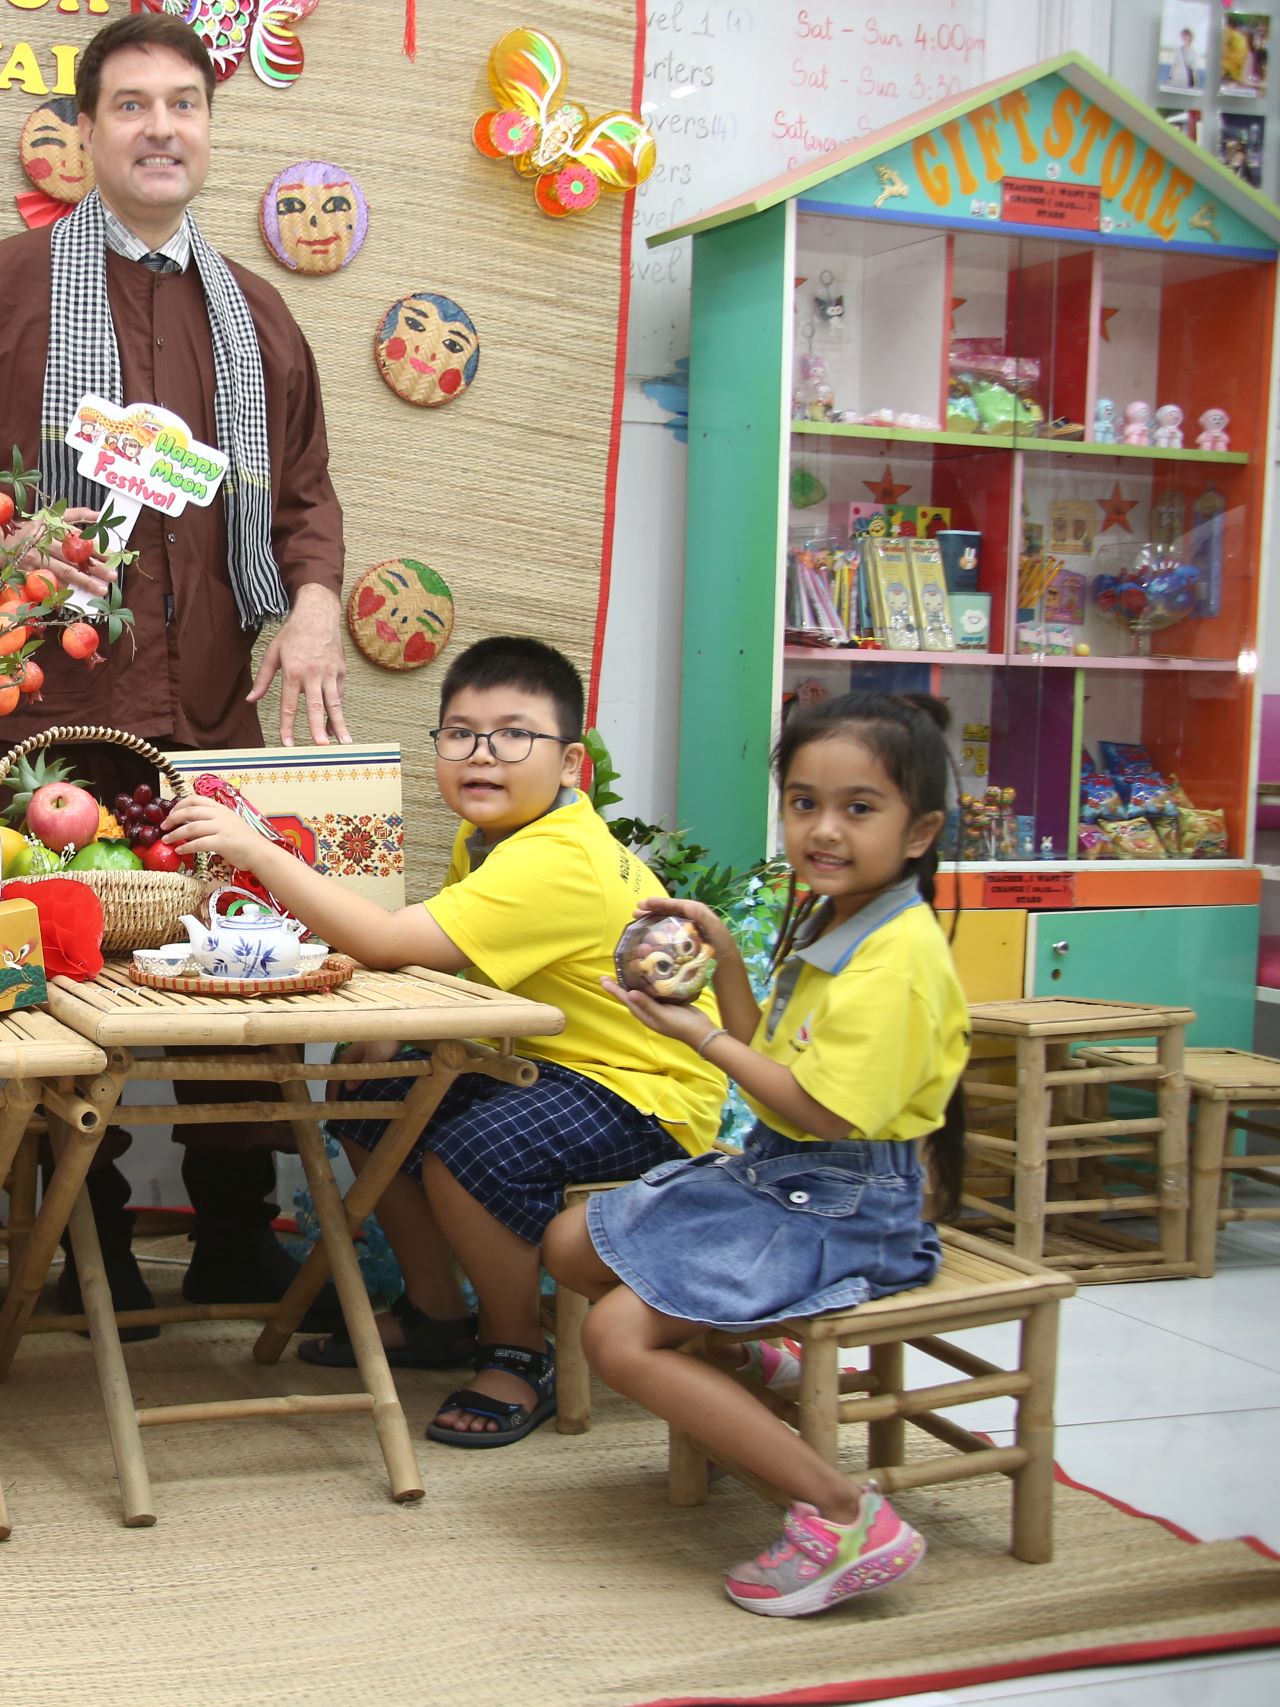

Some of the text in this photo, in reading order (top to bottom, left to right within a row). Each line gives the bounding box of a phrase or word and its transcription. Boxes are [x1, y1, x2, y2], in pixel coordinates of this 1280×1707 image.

[795, 10, 833, 41] Sat
[863, 18, 903, 47] Sun
[914, 23, 986, 63] 4:00pm
[646, 50, 714, 86] rters
[790, 57, 830, 90] Sat
[857, 66, 900, 98] Sun
[772, 110, 807, 139] Sat
[638, 164, 692, 197] ers
[912, 87, 1195, 242] GIFT STORE
[155, 433, 224, 481] Happy
[94, 451, 176, 510] Festival
[150, 458, 207, 499] Moon
